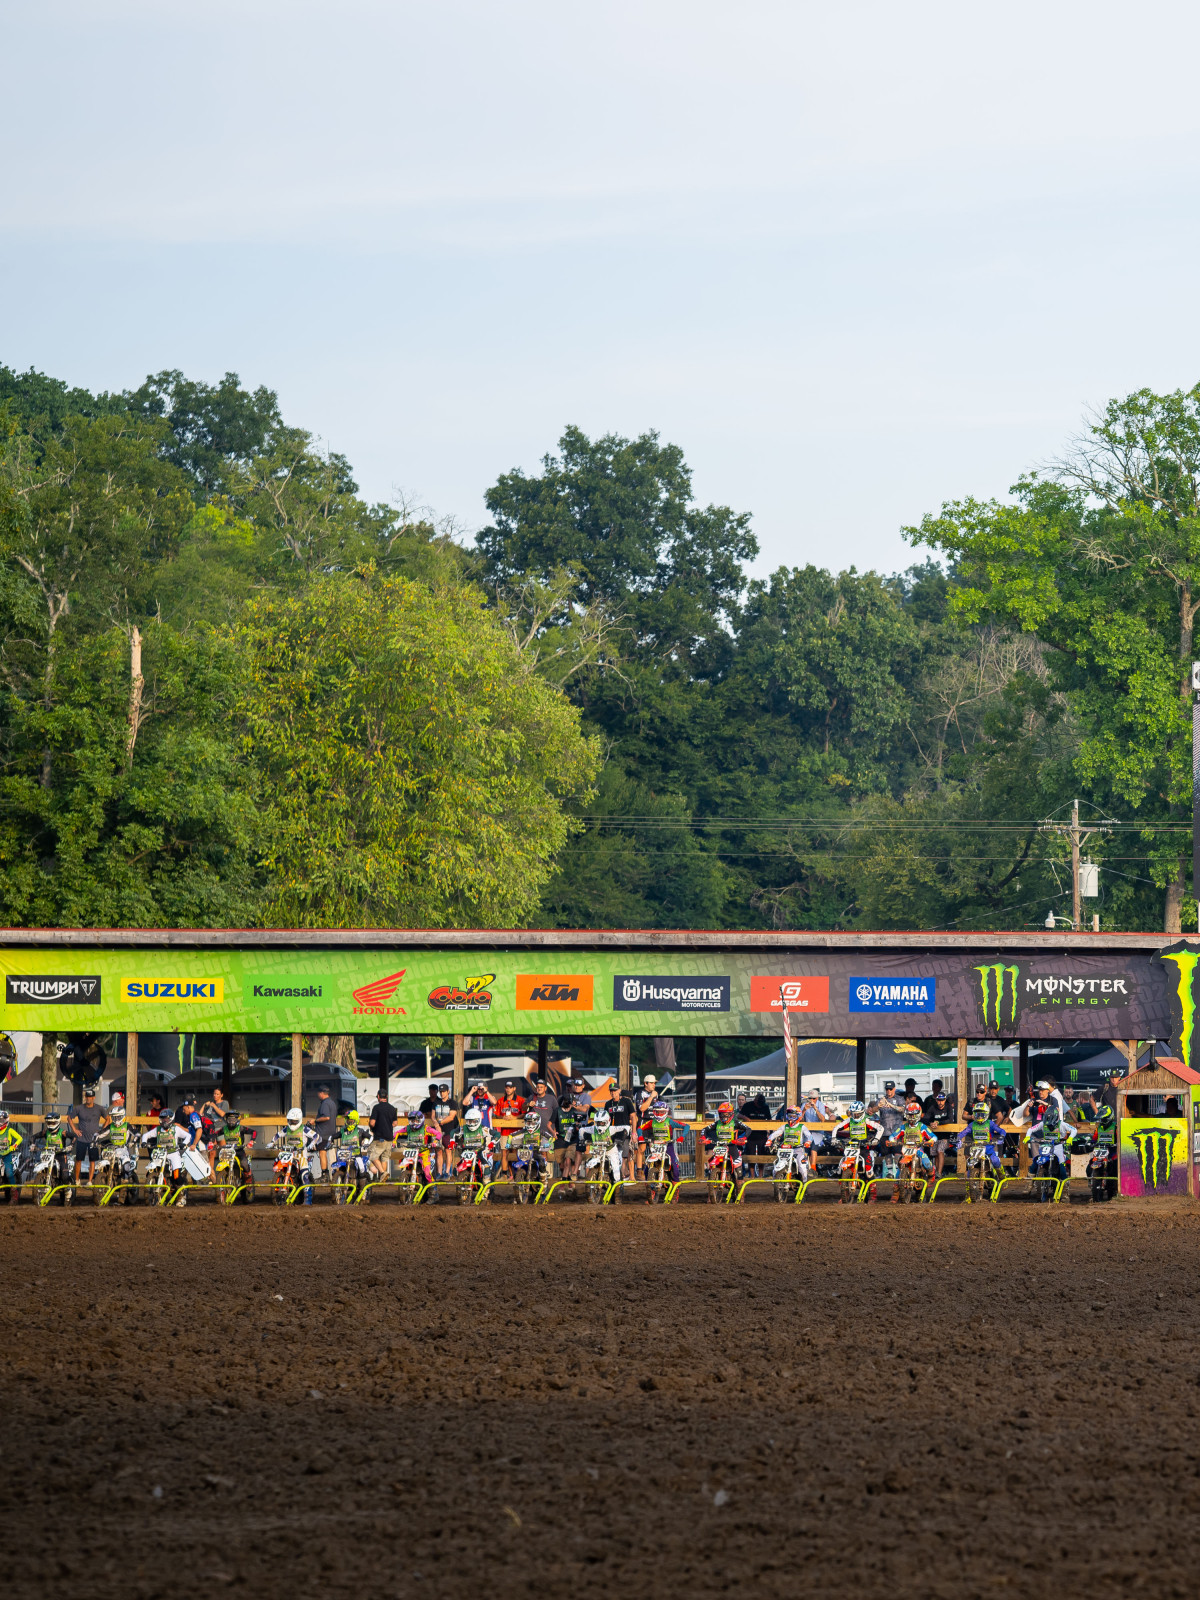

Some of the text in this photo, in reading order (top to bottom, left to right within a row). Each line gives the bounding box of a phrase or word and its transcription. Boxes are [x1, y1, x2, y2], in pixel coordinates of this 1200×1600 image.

[10, 981, 79, 997] TRIUMPH
[127, 983, 215, 998] SUZUKI
[253, 985, 323, 998] Kawasaki
[529, 984, 580, 1001] KTM
[642, 985, 722, 1002] Husqvarna
[872, 985, 929, 1001] YAMAHA
[1025, 976, 1129, 996] MONSTER
[428, 986, 494, 1010] Cobra
[1040, 997, 1111, 1005] ENERGY
[352, 1006, 408, 1016] HONDA
[731, 1085, 748, 1097] THE
[750, 1085, 773, 1098] BEST
[846, 1149, 858, 1157] 72
[1041, 1147, 1050, 1155] 9
